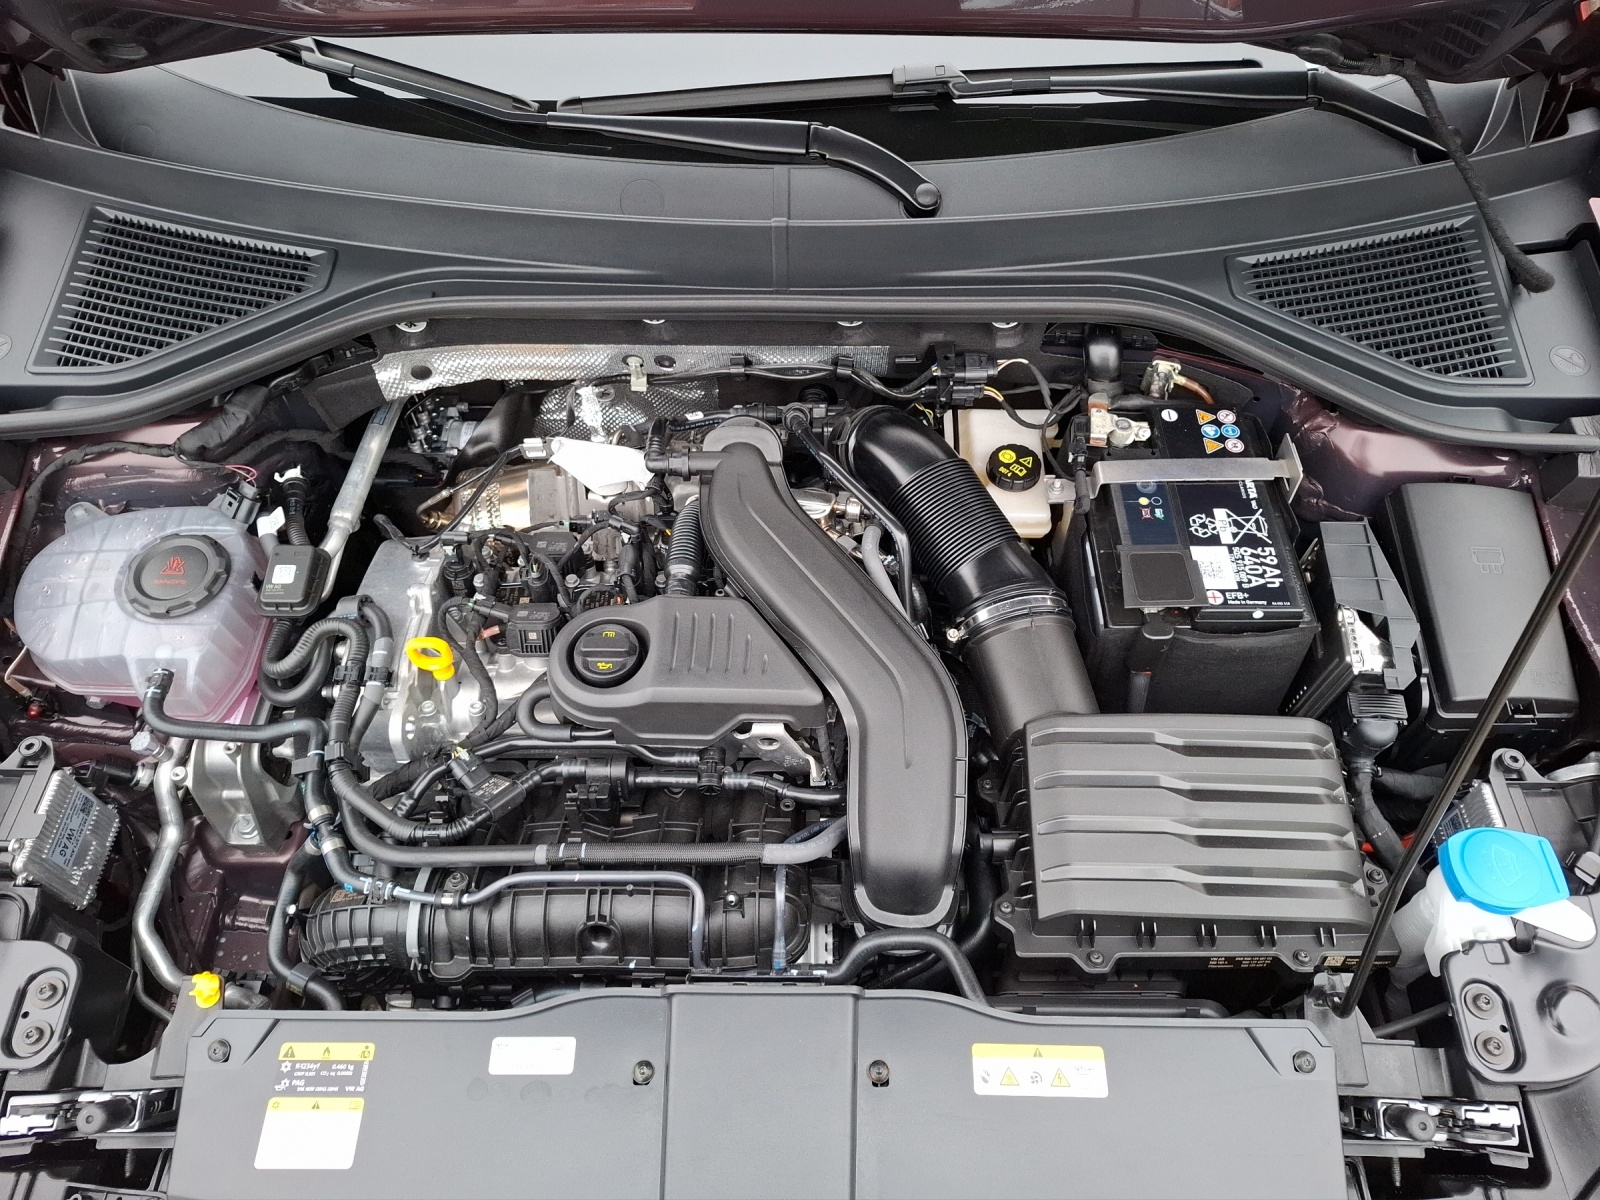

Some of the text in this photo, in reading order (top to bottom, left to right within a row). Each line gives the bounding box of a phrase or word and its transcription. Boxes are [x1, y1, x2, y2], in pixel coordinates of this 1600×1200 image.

[999, 466, 1009, 474] DOT
[1245, 480, 1258, 499] ARTA
[1241, 547, 1266, 588] 640A
[1258, 547, 1283, 588] 59Ah
[1225, 592, 1249, 600] EFB+
[59, 828, 77, 858] VW AG
[295, 1063, 321, 1071] R-1234yf
[347, 1063, 354, 1071] kg
